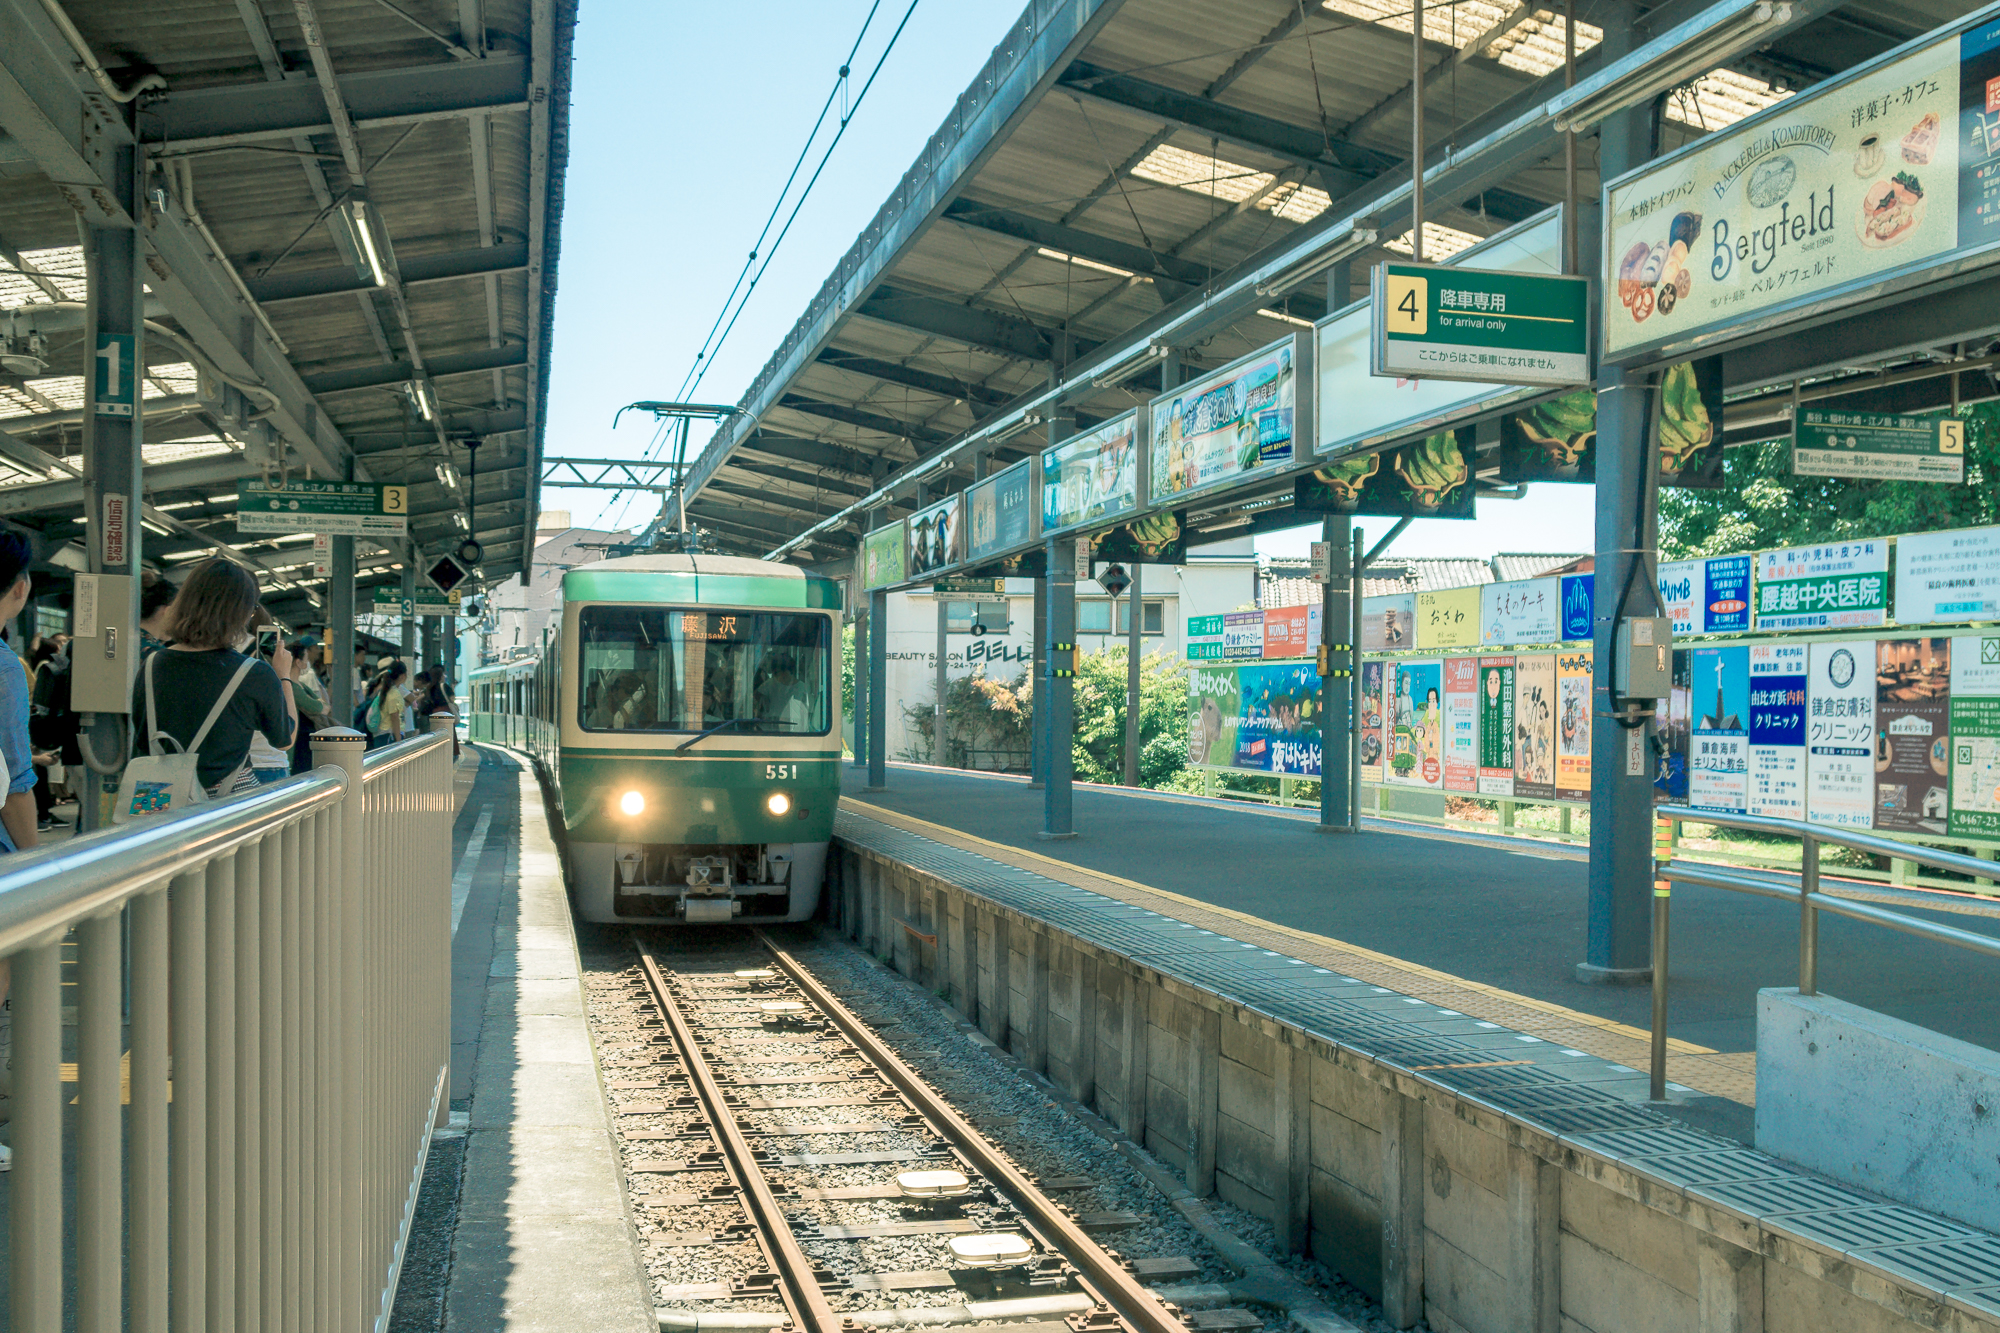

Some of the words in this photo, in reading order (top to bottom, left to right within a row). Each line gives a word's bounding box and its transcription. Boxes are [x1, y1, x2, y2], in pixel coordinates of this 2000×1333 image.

[1851, 80, 1940, 128] 洋菓子・カフェ
[1630, 180, 1696, 220] 本格ドイツパン
[1711, 184, 1834, 282] Bergfeld
[1816, 235, 1834, 248] 1980
[1751, 256, 1836, 292] ベルグフェルド
[1398, 288, 1419, 322] 4
[1440, 288, 1506, 312] 降車専用
[1440, 316, 1453, 326] for
[1455, 316, 1484, 329] arrival
[1486, 319, 1507, 332] only
[96, 341, 120, 396] 1
[1419, 350, 1556, 370] ここからはご乗車になれません
[1182, 378, 1246, 436] 鎌倉ものがたり
[1246, 379, 1277, 410] 西岸良平
[1946, 425, 1957, 448] 5
[1521, 448, 1596, 467] プレミア
[388, 489, 401, 510] 3
[1310, 486, 1380, 501] プレミアム
[1400, 489, 1461, 505] マイルド
[106, 498, 124, 562] 信号確認
[1130, 542, 1176, 555] マイルド
[1768, 564, 1805, 578] 産婦人科
[997, 580, 1003, 590] 5
[451, 591, 458, 602] 3
[1760, 576, 1881, 612] 腰越中央医院
[402, 599, 412, 615] 3
[433, 625, 440, 636] 4
[680, 616, 737, 634] 藤沢
[1672, 622, 1692, 632] 836
[690, 632, 728, 640] FUJISAWA
[1230, 632, 1262, 646] 鎌倉ファミリー
[886, 652, 926, 660] BEAUTY
[966, 640, 1030, 662] BELL
[1753, 647, 1770, 659] 内科
[1776, 648, 1803, 658] 老年内科
[1454, 660, 1475, 680] Ami
[1753, 662, 1780, 672] 健康診断
[1786, 662, 1802, 672] 往診
[1751, 690, 1805, 706] 由比ガ浜内科
[1812, 696, 1872, 718] 鎌倉皮膚科
[1224, 716, 1284, 730] えのすいワンダーアクアリウム
[1502, 668, 1512, 768] 池田整形外科
[1756, 712, 1799, 729] クリニック
[1811, 722, 1872, 742] クリニック
[1702, 742, 1738, 756] 鎌倉海岸
[766, 764, 797, 780] 551
[1694, 758, 1746, 771] キリスト教会
[1829, 764, 1852, 772] 休診日
[1810, 812, 1820, 820] Tel
